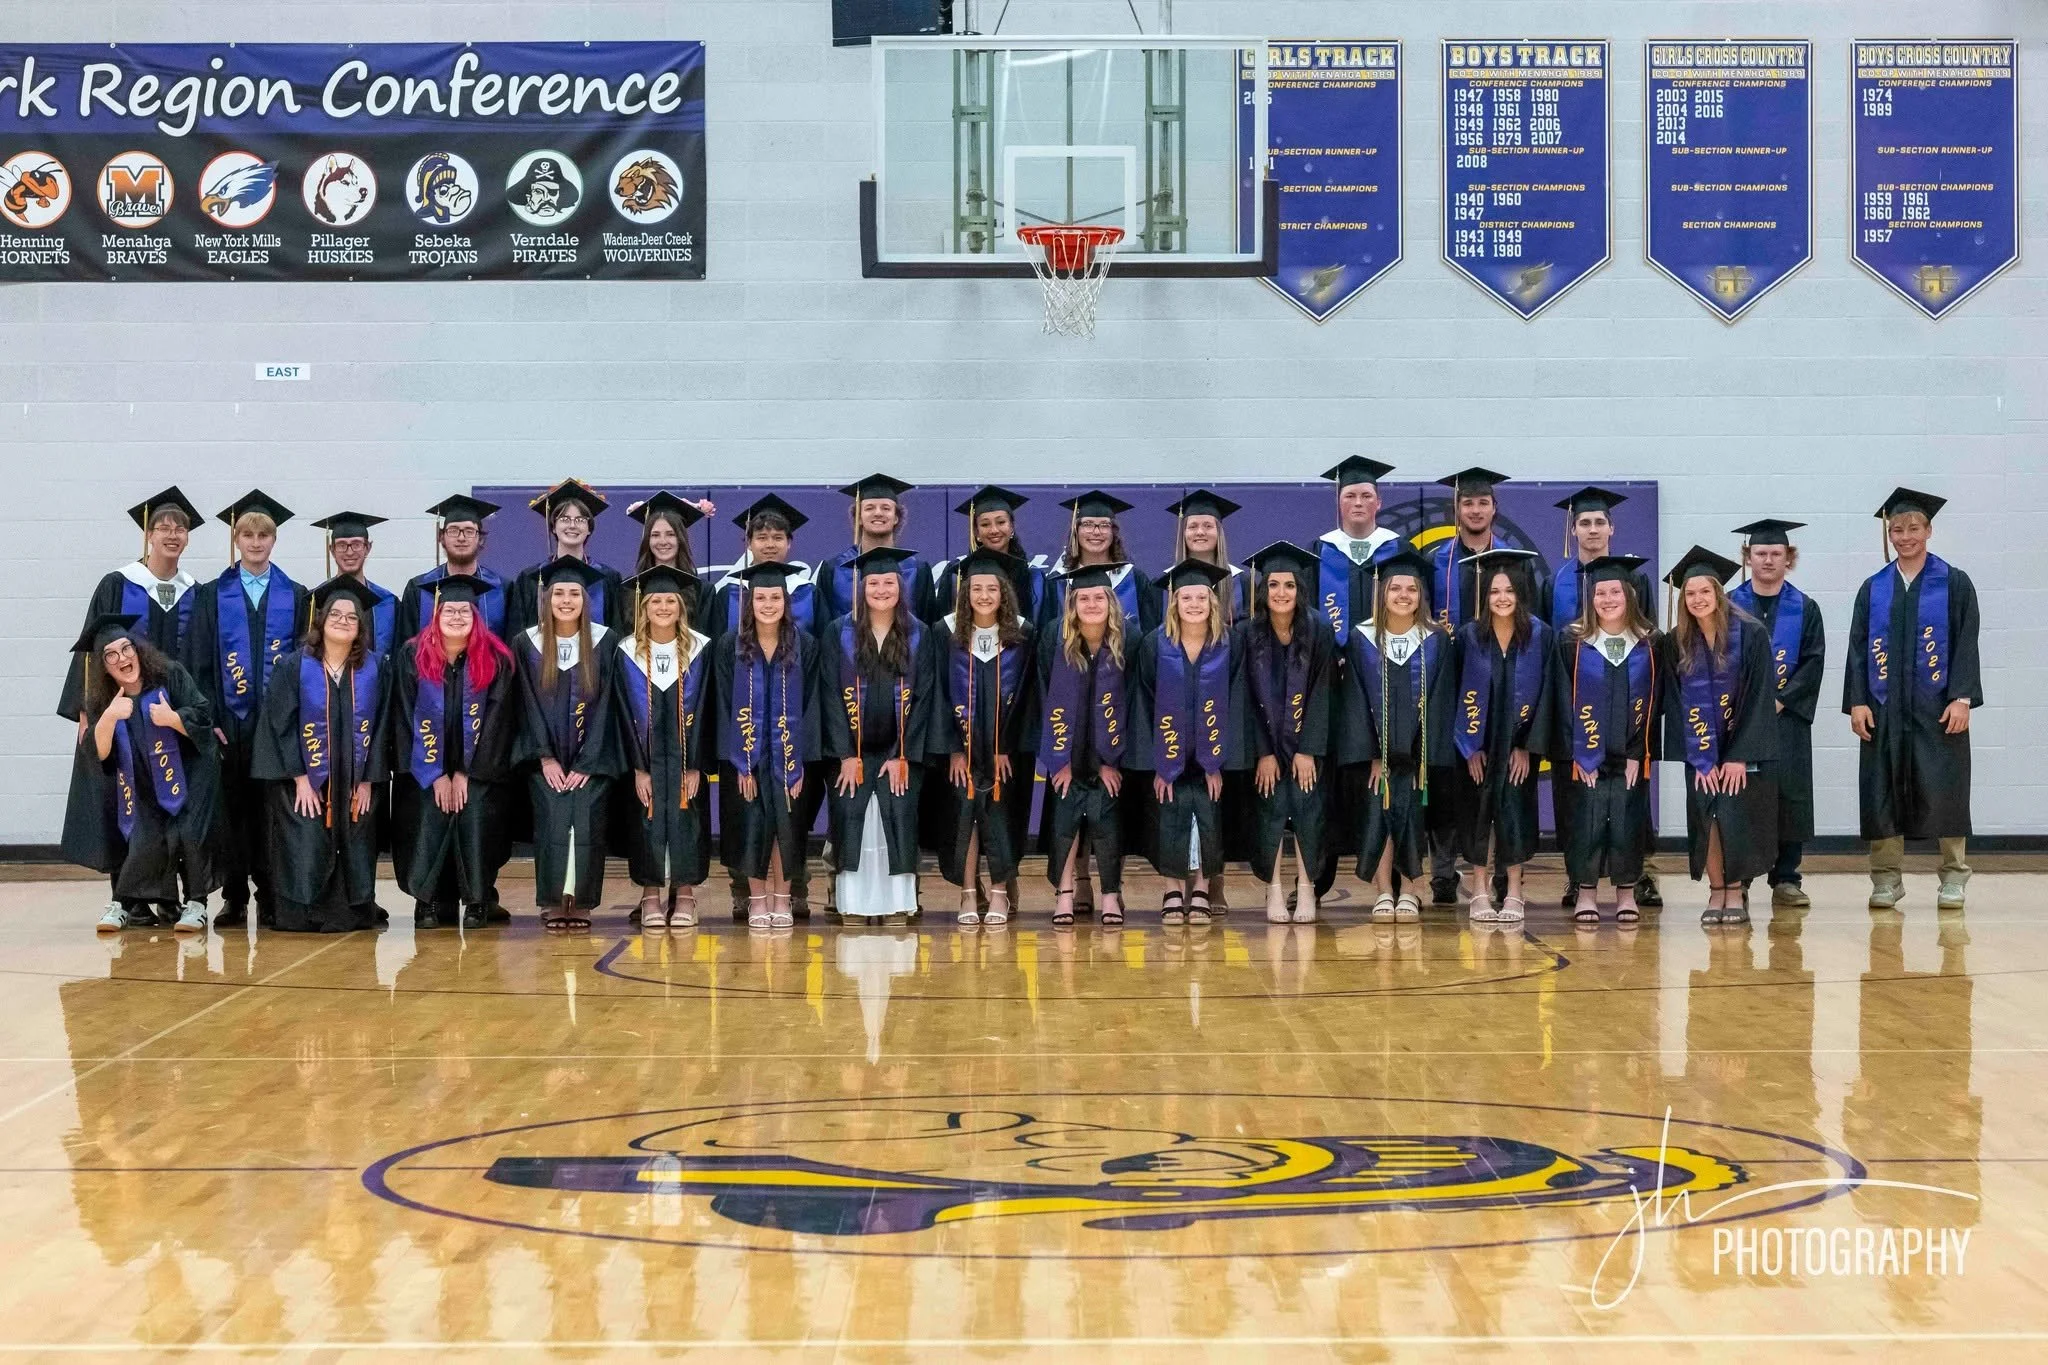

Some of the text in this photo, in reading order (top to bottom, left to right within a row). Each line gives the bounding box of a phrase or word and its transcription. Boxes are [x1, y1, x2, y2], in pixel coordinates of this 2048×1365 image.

[1242, 47, 1395, 67] GRLS TRACK
[1450, 46, 1602, 66] BOYS TRACK
[1652, 46, 1806, 66] GIRLS CROSS COUNTRY
[1858, 46, 2011, 66] BOYS CROSS COUNTRY
[1452, 70, 1600, 78] CO-OP WITH MENAHGA 1989
[1655, 70, 1802, 78] CO-OP WITH MENAHGA 1989
[1672, 80, 1786, 88] CONFERENCE CHAMPIONS
[80, 57, 301, 137] Region
[322, 52, 682, 118] Conference
[1244, 92, 1272, 104] 205
[1454, 89, 1559, 102] 1947 1958 1980
[1656, 89, 1724, 103] 2003 2015
[1862, 88, 1892, 101] 1974
[1454, 104, 1558, 116] 1948 1961 1981
[1656, 104, 1724, 118] 2004 2016
[1864, 103, 1892, 116] 1989
[1454, 118, 1560, 131] 1949 1962 2006
[1657, 117, 1686, 130] 2013
[1455, 132, 1562, 146] 1956 1979 2007
[1656, 132, 1686, 144] 2014
[1268, 148, 1377, 156] UB-SECTION RUNNER-UP
[1878, 146, 1993, 154] SUB-SECTION RUNNER-UP
[1249, 157, 1274, 170] 11
[1456, 155, 1488, 168] 2008
[107, 165, 164, 217] M
[1468, 184, 1586, 192] SUB-SECTION CHAMPIONS
[1671, 184, 1788, 192] SUB-SECTION CHAMPIONS
[1455, 193, 1522, 206] 1940 1960
[1864, 193, 1928, 206] 1959 1961
[110, 200, 161, 218] Braves
[1454, 208, 1484, 220] 1947
[1864, 207, 1930, 220] 1960 1962
[1279, 222, 1368, 230] STRICT CHAMPIONS
[0, 234, 65, 251] Henning
[102, 234, 172, 252] Menahga
[195, 234, 281, 248] New York Mills
[311, 234, 370, 251] Pillager
[415, 234, 471, 248] Sebeka
[510, 233, 579, 247] Verndale
[602, 232, 692, 246] Wadena-Deer Creek
[1455, 230, 1522, 243] 1943 1949
[1864, 230, 1892, 242] 1957
[0, 251, 70, 264] HORNETS
[107, 250, 167, 264] BRAVES
[207, 250, 270, 264] EAGLES
[308, 250, 374, 264] HUSKIES
[408, 250, 478, 265] TROJANS
[512, 249, 577, 263] PIRATES
[603, 249, 692, 262] WOLVERINES
[1454, 244, 1522, 258] 1944 1980
[266, 367, 300, 377] EAST
[1324, 592, 1344, 633] SHS
[1872, 638, 1888, 680] SHS
[1923, 626, 1941, 681] 2026
[226, 652, 247, 695] SHS
[1775, 650, 1788, 690] 202
[843, 686, 859, 730] SHS
[1292, 693, 1303, 733] 202
[1463, 690, 1481, 735] SHS
[1719, 694, 1736, 732] 202
[469, 703, 481, 746] 202
[575, 702, 586, 743] 202
[1101, 692, 1120, 746] 2026
[1050, 708, 1069, 751] SHS
[1203, 700, 1222, 757] 2026
[1579, 705, 1601, 750] SHS
[1688, 708, 1712, 751] SHS
[419, 719, 438, 764] SHS
[1159, 715, 1180, 760] SHS
[303, 722, 323, 768] SHS
[154, 740, 181, 795] 2026
[118, 772, 133, 816] SHS
